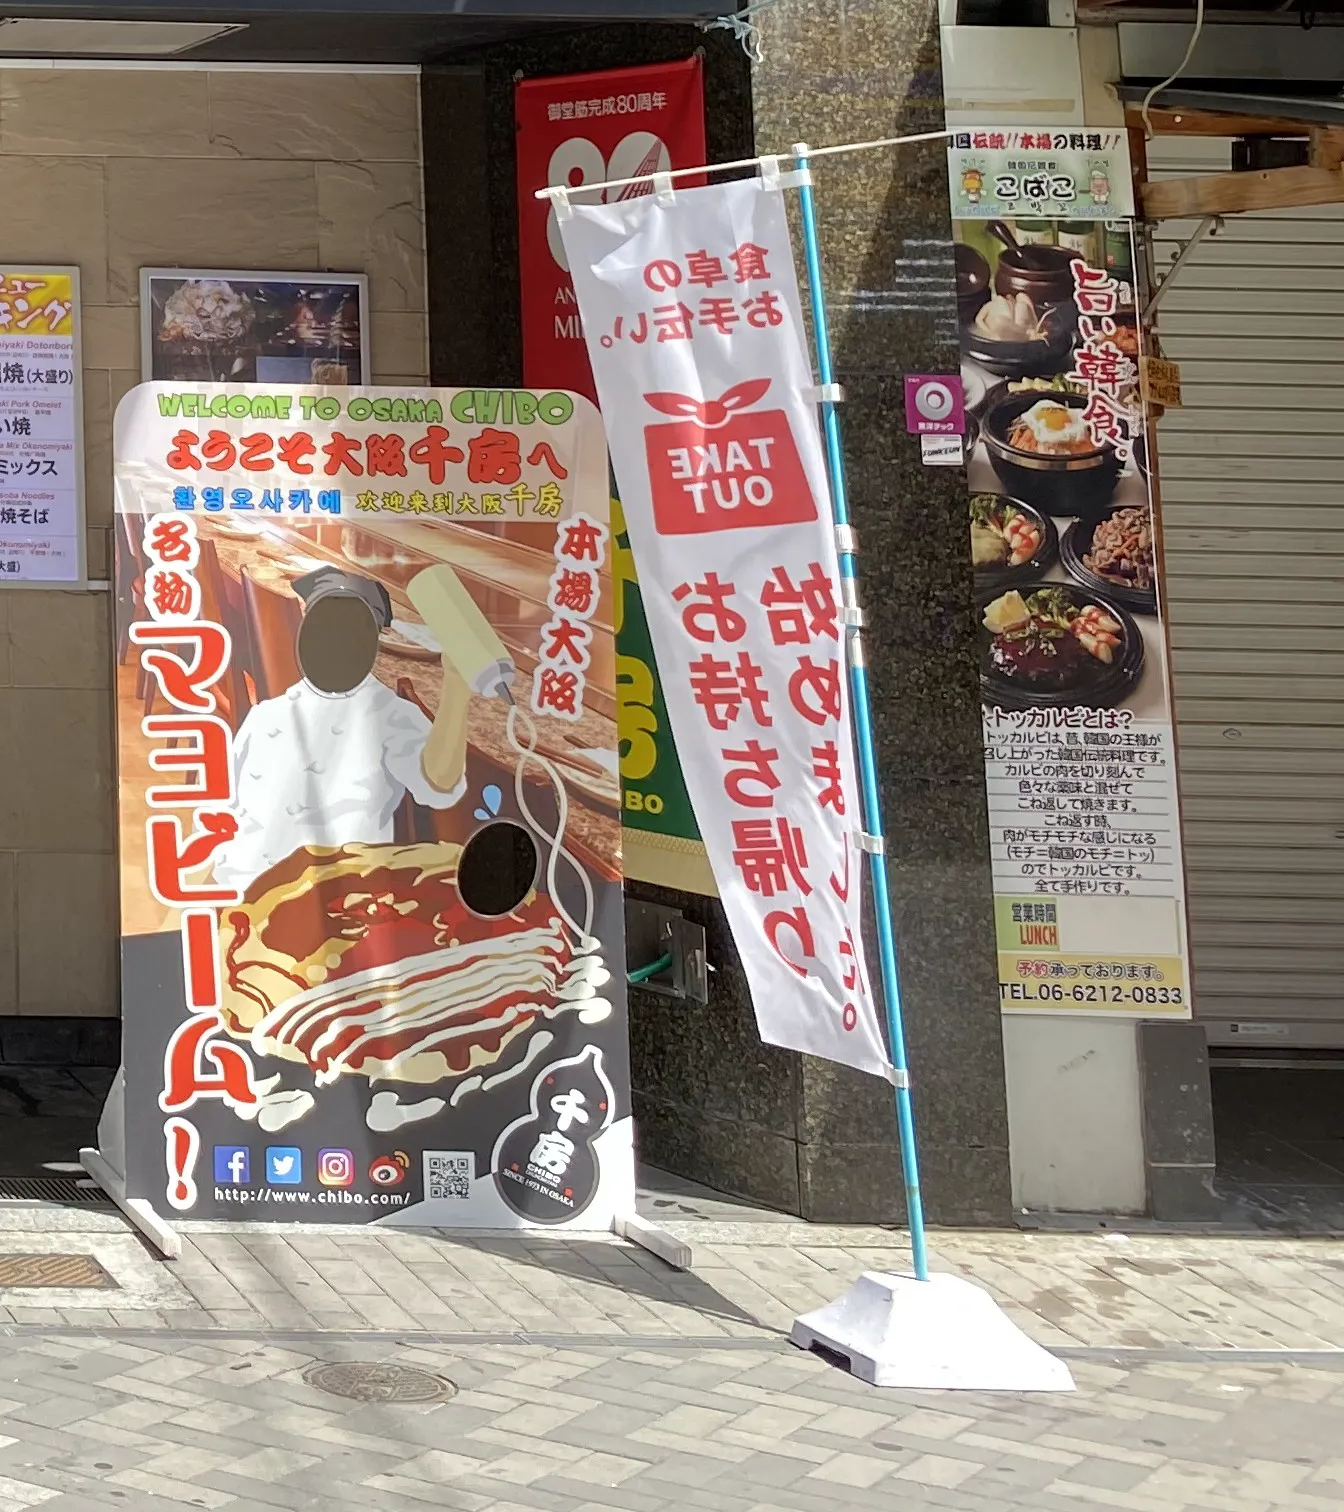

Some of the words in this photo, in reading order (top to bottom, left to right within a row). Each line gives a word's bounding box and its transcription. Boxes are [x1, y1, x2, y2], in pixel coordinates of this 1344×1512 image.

[996, 175, 1074, 199] こばこ
[157, 393, 292, 419] WELCOME
[301, 395, 343, 421] TO
[347, 396, 443, 424] OSAKA
[450, 390, 574, 426] CHIBO
[167, 426, 568, 485] ようこそ大阪千房へ
[355, 482, 564, 517] 欢迎来到大阪千房
[150, 519, 195, 614] 名物
[537, 519, 603, 714] 本場大阪
[1005, 765, 1145, 778] カルビの肉を切り刻んで
[1018, 781, 1133, 794] 色々な薬味と混ぜて
[1018, 798, 1137, 813] こね返して焼きます。
[1044, 815, 1112, 829] こね返す時、
[1003, 830, 1156, 845] 肉がモチモチな感じになる
[1021, 864, 1142, 879] のでトッカルビです。
[1035, 881, 1130, 895] 全て手作りです。
[1012, 903, 1056, 923] 営業時間
[1020, 925, 1057, 945] LUNCH
[1018, 961, 1164, 980] 予約承っております。
[999, 983, 1182, 1004] TEL.06-6212-0833
[530, 1088, 589, 1175] 千房
[214, 1187, 410, 1206] http://www.chibo.com/
[503, 1168, 525, 1184] SINCE
[549, 1190, 574, 1207] OSAKA
